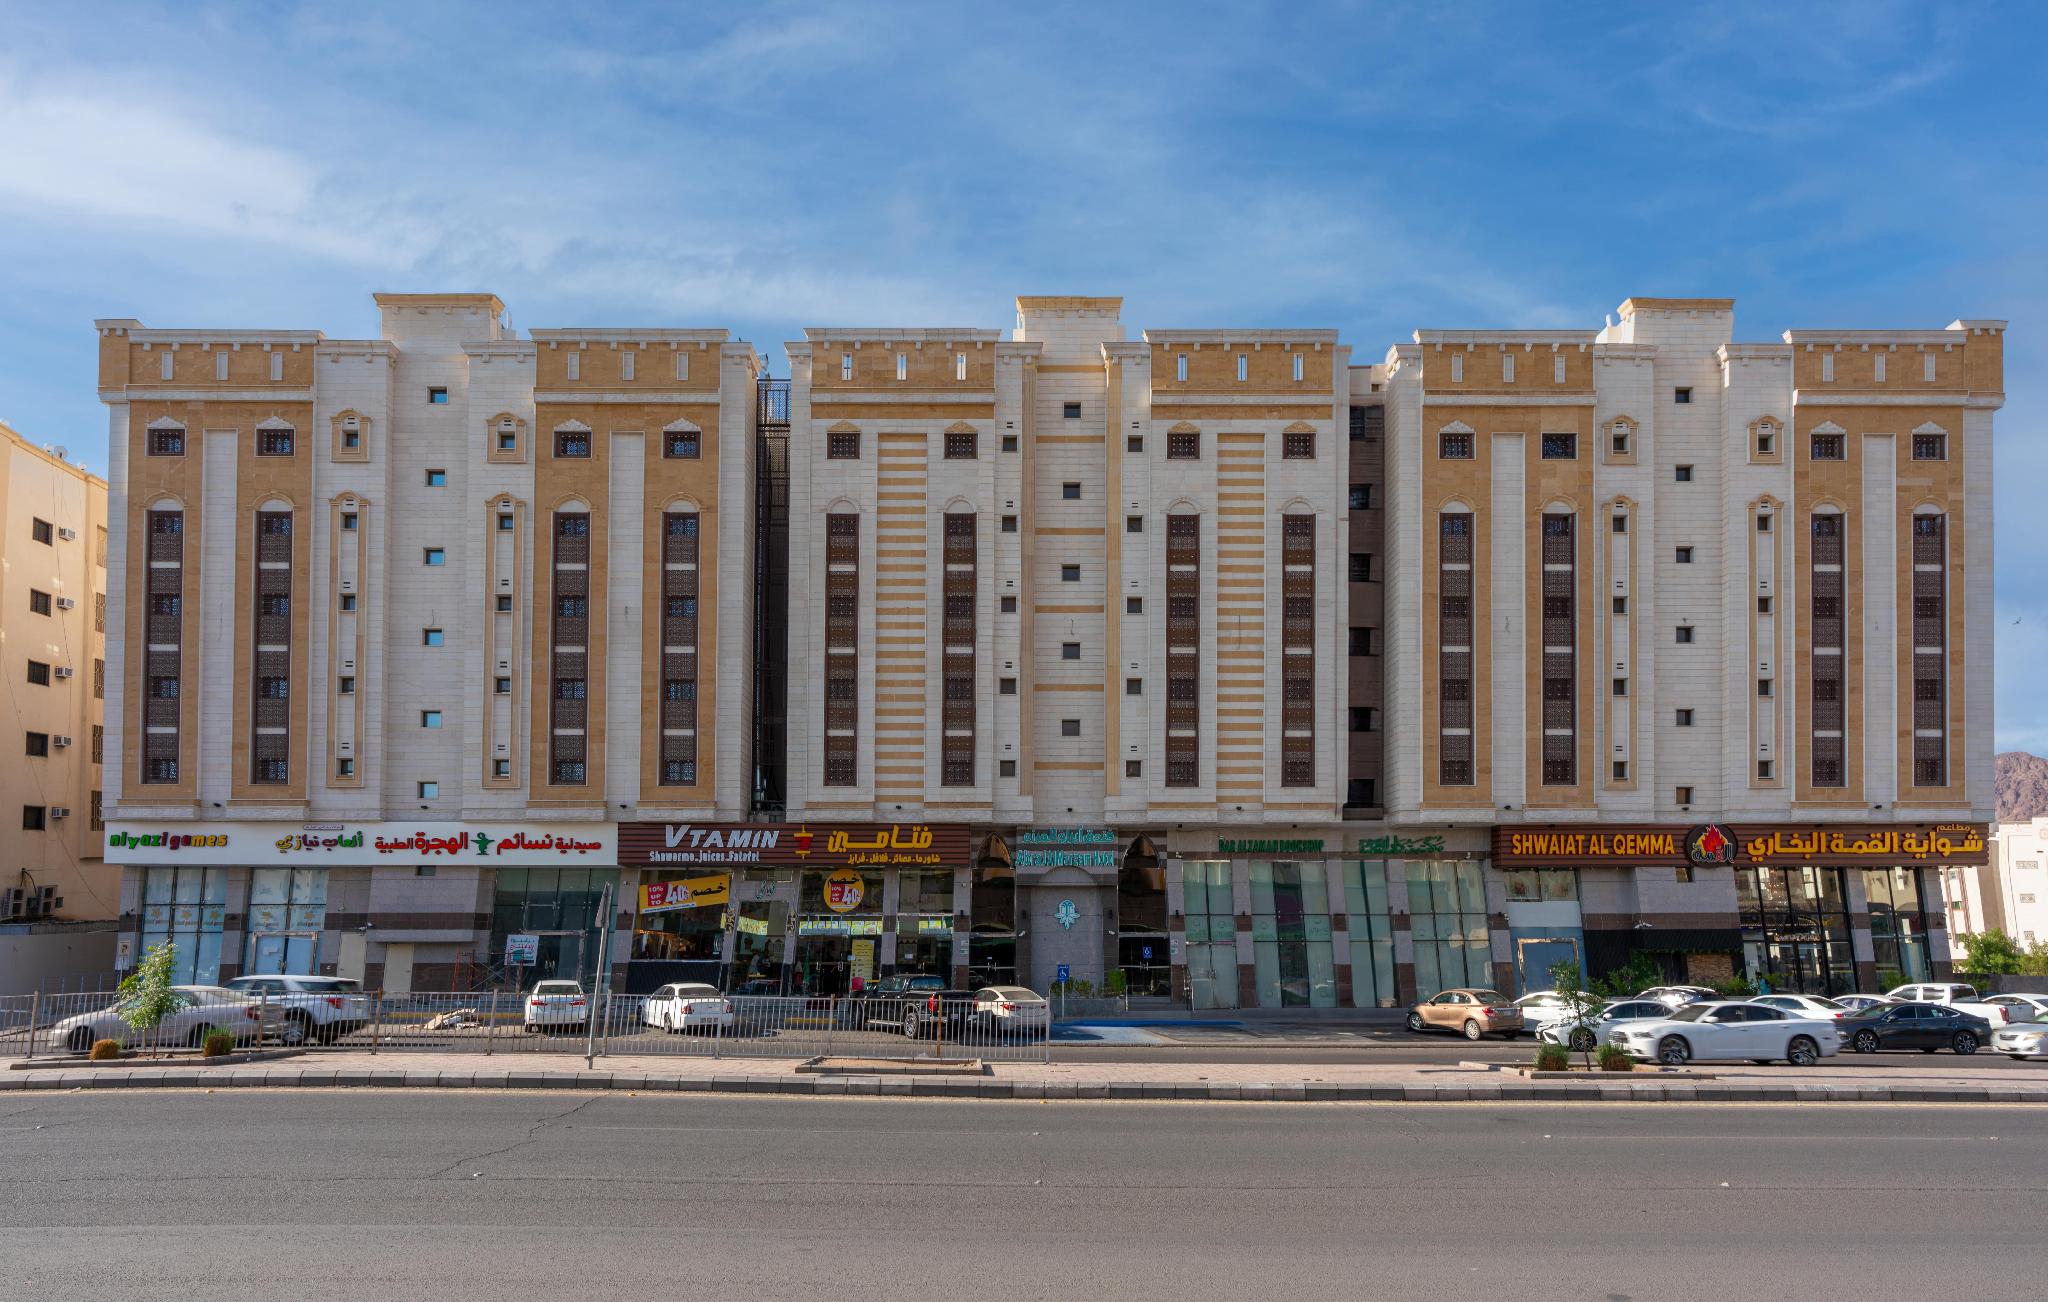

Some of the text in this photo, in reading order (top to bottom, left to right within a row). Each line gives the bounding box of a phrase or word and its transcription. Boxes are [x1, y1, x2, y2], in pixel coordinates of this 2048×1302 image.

[169, 834, 228, 850] games
[275, 831, 363, 853] ألعاب نيازي
[374, 832, 469, 855] الهجرة الطبية
[496, 832, 602, 855] صيدلية نسائم
[665, 824, 780, 848] VTAMIN
[827, 825, 932, 852] فتامين
[1512, 834, 1675, 855] SHWAIAT AL QEMMA
[1747, 829, 1983, 862] شواية القمة البخاري
[691, 882, 726, 900] خصم
